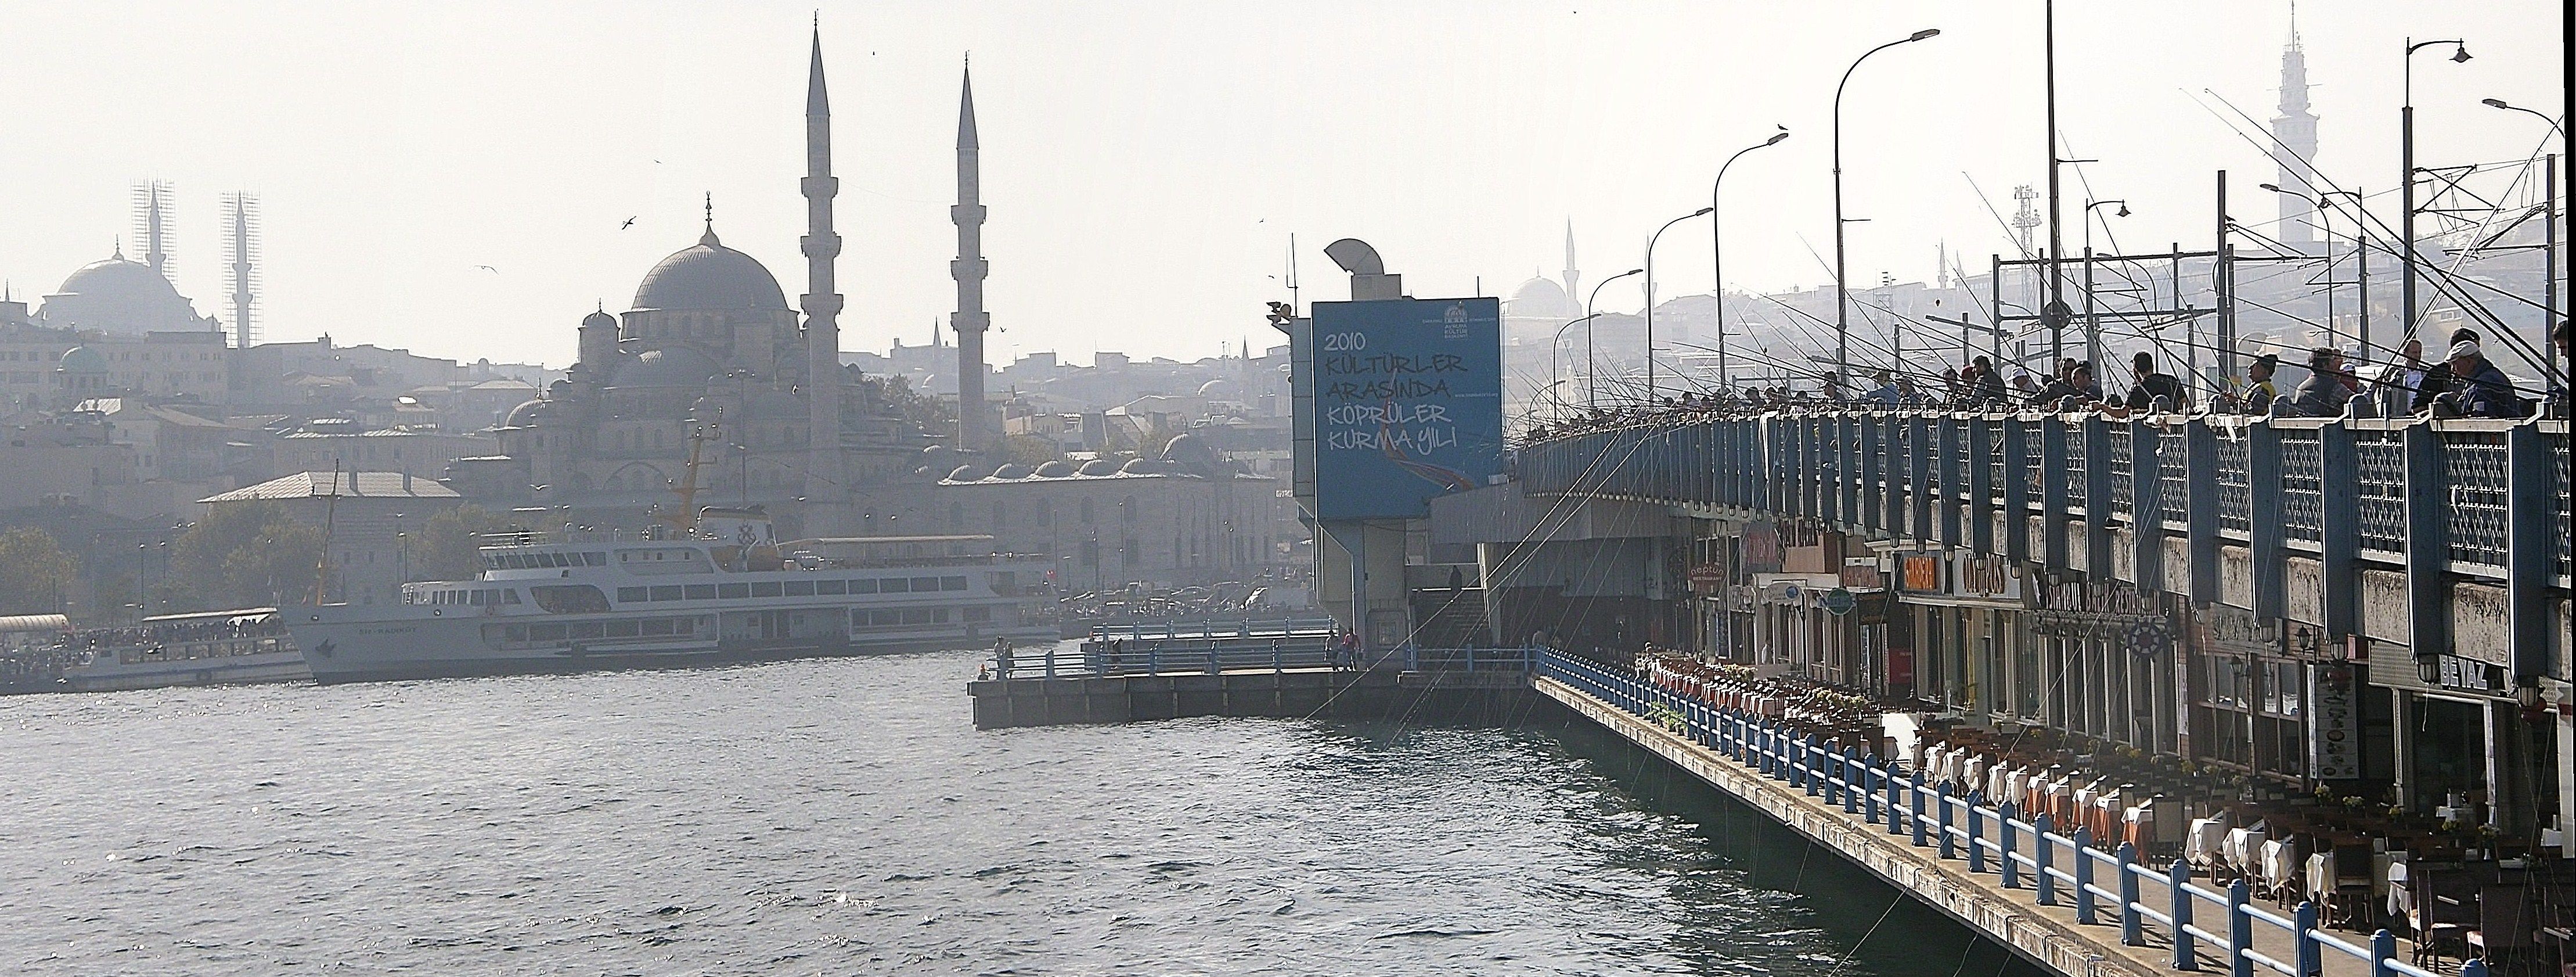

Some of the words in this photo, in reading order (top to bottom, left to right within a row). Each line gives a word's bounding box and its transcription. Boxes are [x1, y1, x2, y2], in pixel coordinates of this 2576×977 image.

[1324, 332, 1366, 351] 2010
[1325, 351, 1468, 376] KÜLTÜRLER
[1325, 378, 1451, 401] ARASINDA
[1327, 401, 1452, 426] KÖPRÜLER
[1328, 428, 1413, 450] KURMA
[2438, 654, 2488, 690] BEYAZ
